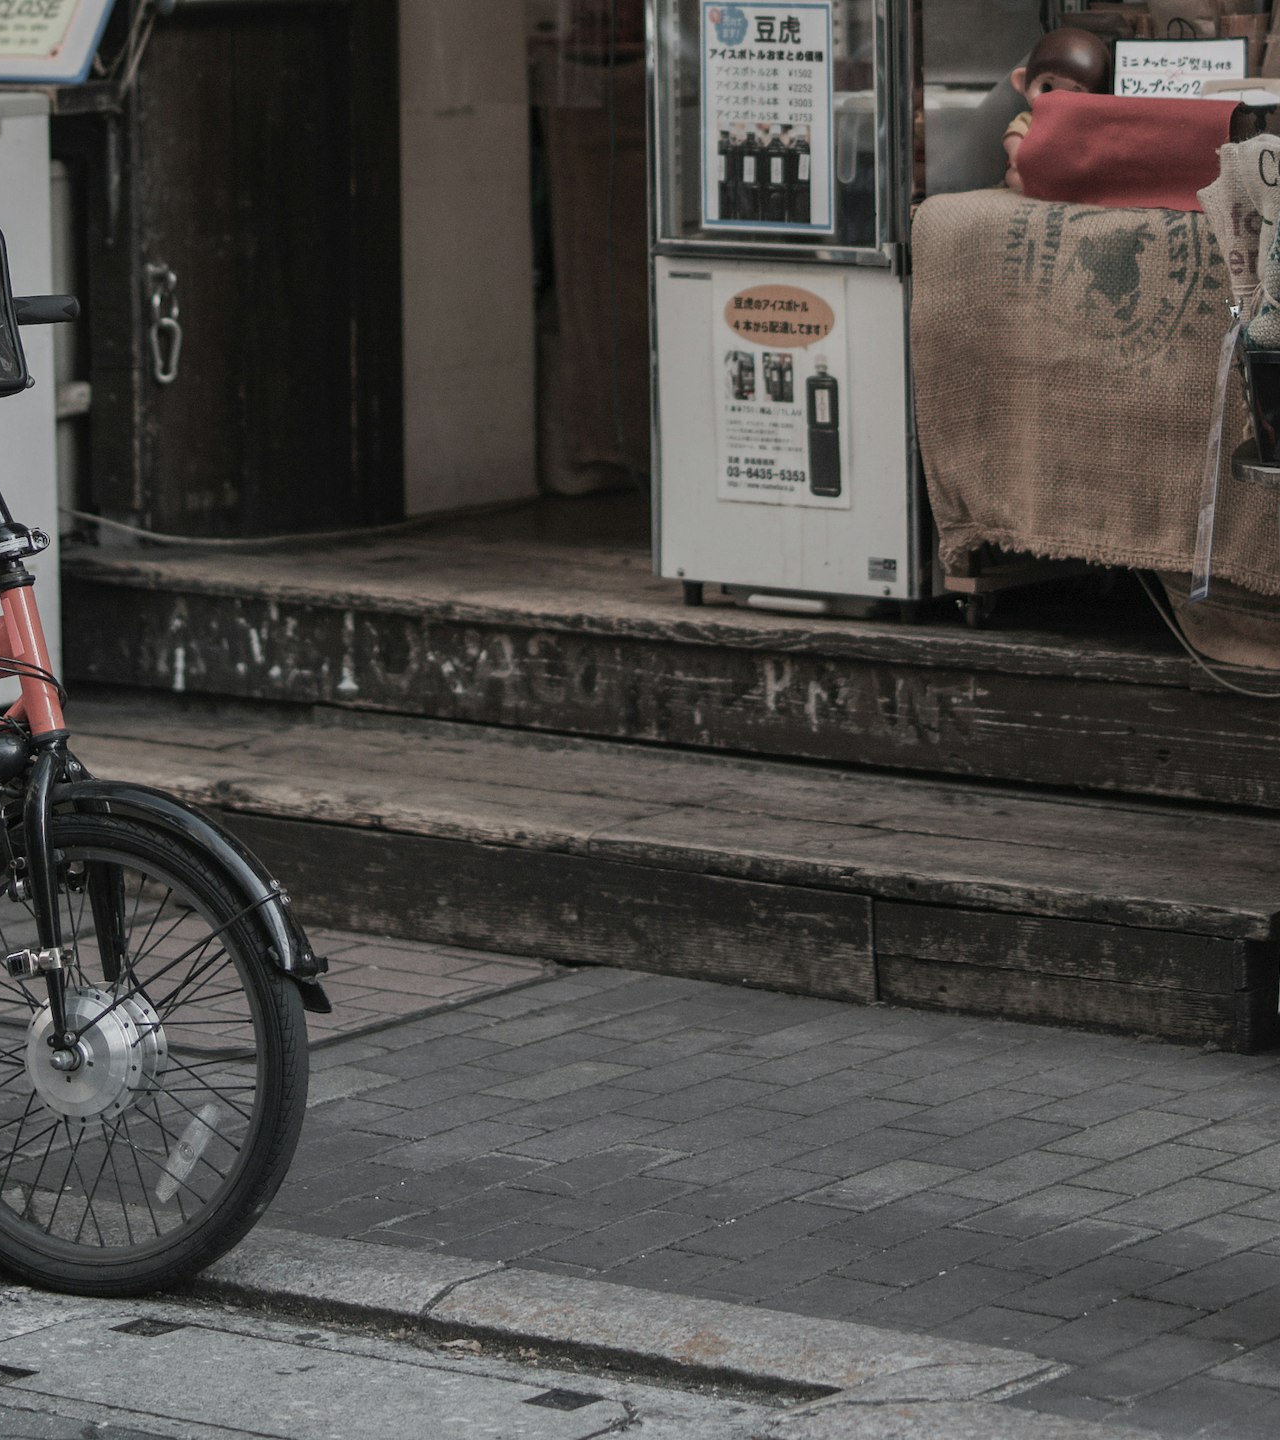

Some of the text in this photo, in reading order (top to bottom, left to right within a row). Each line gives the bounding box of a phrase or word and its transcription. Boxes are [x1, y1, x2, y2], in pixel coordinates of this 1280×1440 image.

[753, 15, 802, 45] 豆虎
[733, 296, 809, 313] 豆虎のアイスボトル
[726, 465, 807, 482] 03-6435-5353
